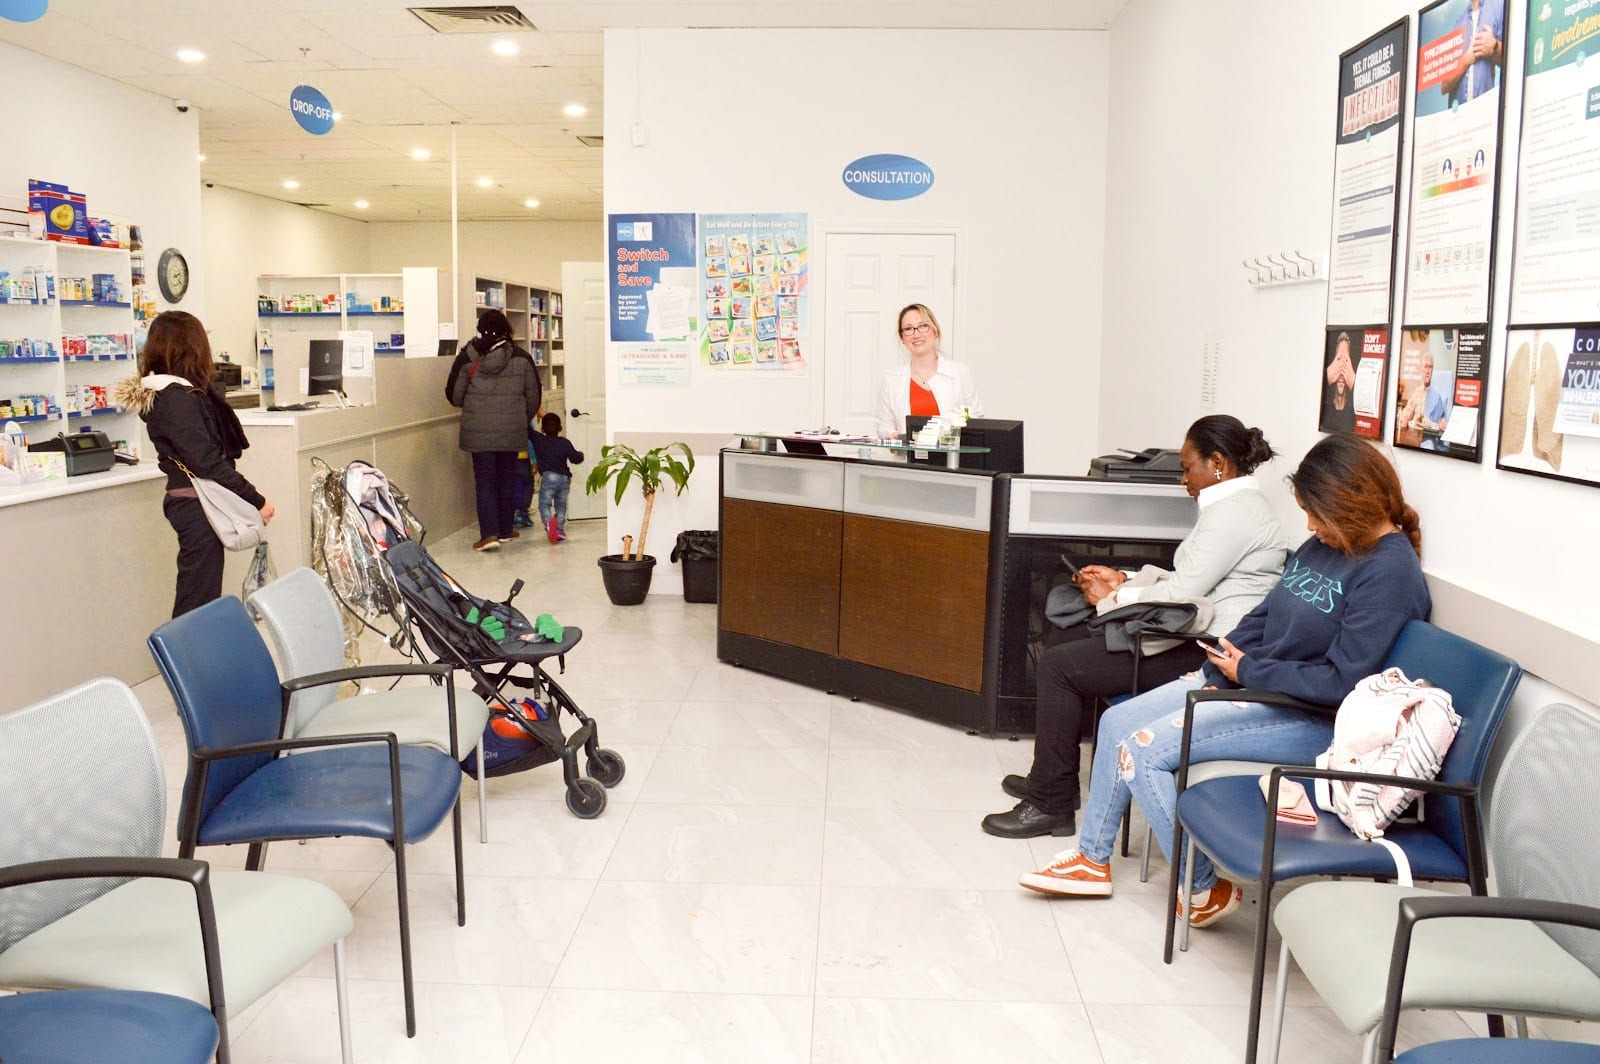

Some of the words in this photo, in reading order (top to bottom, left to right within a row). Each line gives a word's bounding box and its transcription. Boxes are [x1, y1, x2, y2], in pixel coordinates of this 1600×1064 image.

[1368, 49, 1382, 68] COULD
[1382, 45, 1390, 61] BE
[1389, 43, 1394, 57] A
[1372, 61, 1391, 80] FUNGUS
[1344, 74, 1398, 121] INFECTION
[293, 98, 331, 120] DROP-OFF
[844, 170, 931, 184] CONSULTATION
[617, 247, 670, 261] Switch
[617, 262, 639, 272] and
[618, 273, 652, 286] Save
